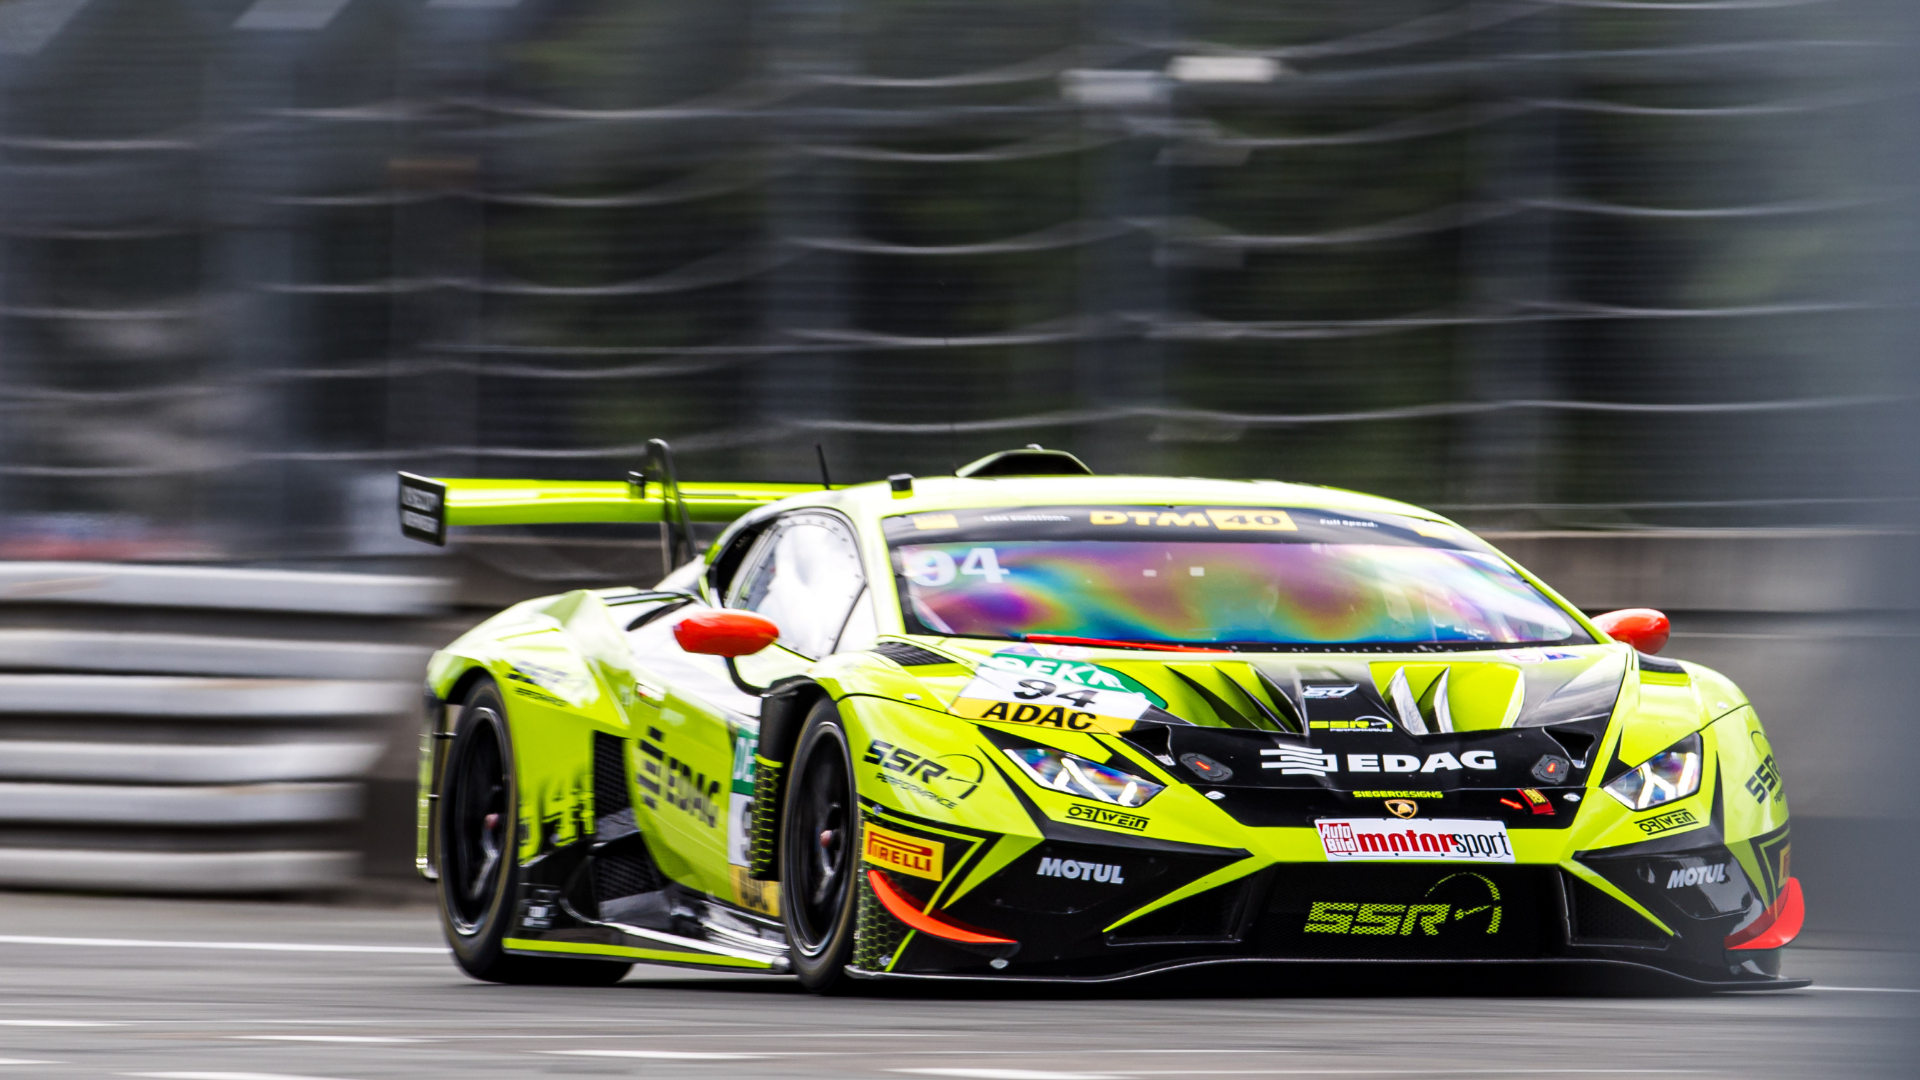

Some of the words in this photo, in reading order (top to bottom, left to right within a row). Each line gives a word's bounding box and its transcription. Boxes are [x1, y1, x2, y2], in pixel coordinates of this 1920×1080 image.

[1089, 510, 1209, 527] DTM
[1224, 513, 1282, 527] 40
[902, 547, 1010, 586] 94
[1013, 679, 1100, 708] 94
[981, 702, 1097, 731] ADAC
[1309, 720, 1370, 729] SSR
[862, 739, 948, 785] SSR
[1347, 751, 1497, 773] EDAG
[875, 772, 957, 810] PERFORMANCE
[1352, 790, 1444, 799] SIEGERDESIGNS
[1322, 823, 1352, 838] Auto
[868, 831, 933, 872] PIRELLI
[1325, 838, 1357, 852] Bild
[1037, 857, 1124, 884] MOTUL
[1667, 863, 1726, 889] MOTUL
[1304, 902, 1451, 935] SSR
